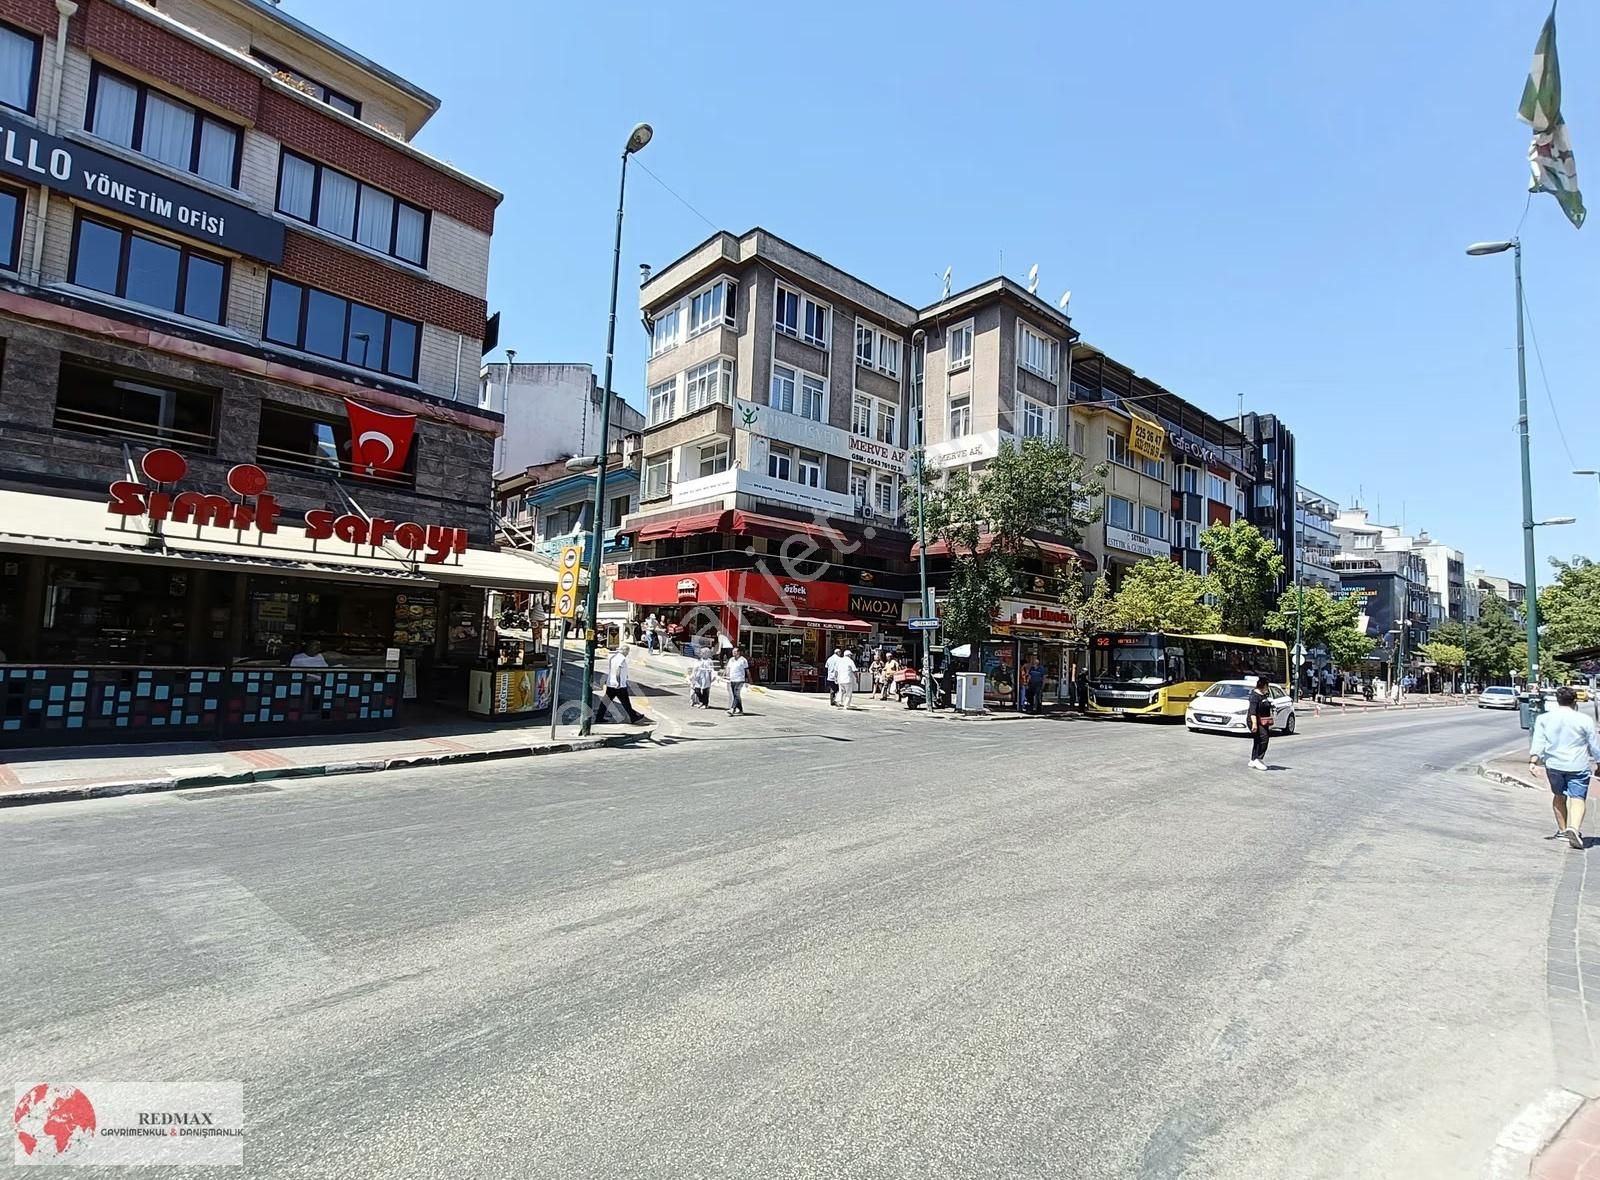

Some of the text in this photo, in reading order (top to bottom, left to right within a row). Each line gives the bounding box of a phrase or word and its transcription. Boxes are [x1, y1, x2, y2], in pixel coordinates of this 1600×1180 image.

[0, 127, 226, 237] LLO YÖNETİM OFİSİ
[850, 437, 906, 463] MERVE AK
[940, 449, 967, 462] MERVE
[969, 445, 983, 457] AK
[784, 584, 807, 595] özbek
